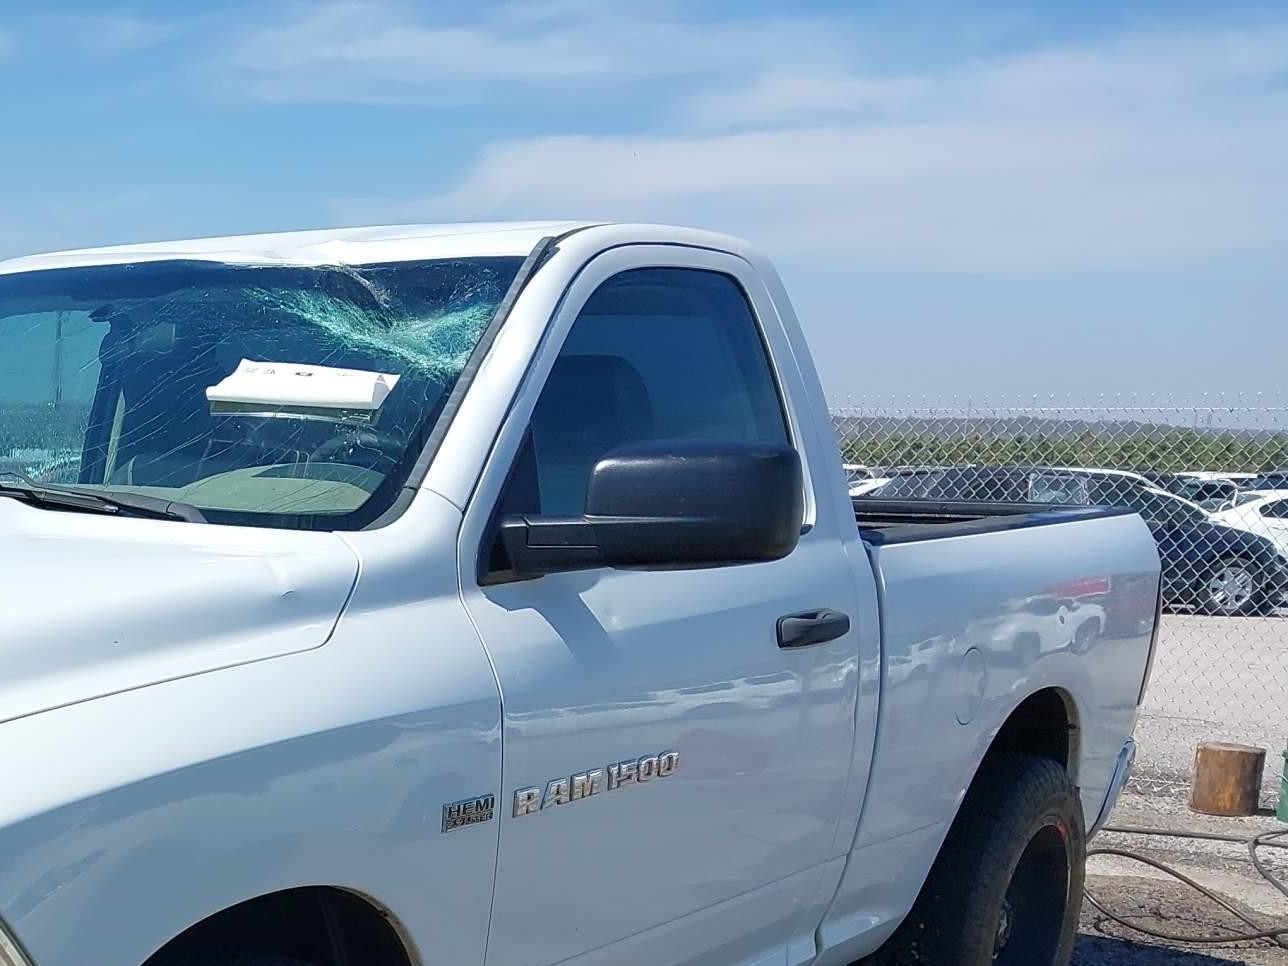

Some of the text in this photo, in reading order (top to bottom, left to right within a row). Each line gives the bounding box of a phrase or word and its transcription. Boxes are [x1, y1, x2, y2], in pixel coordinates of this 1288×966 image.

[512, 749, 680, 818] RAM 1500
[447, 796, 495, 819] HEMI
